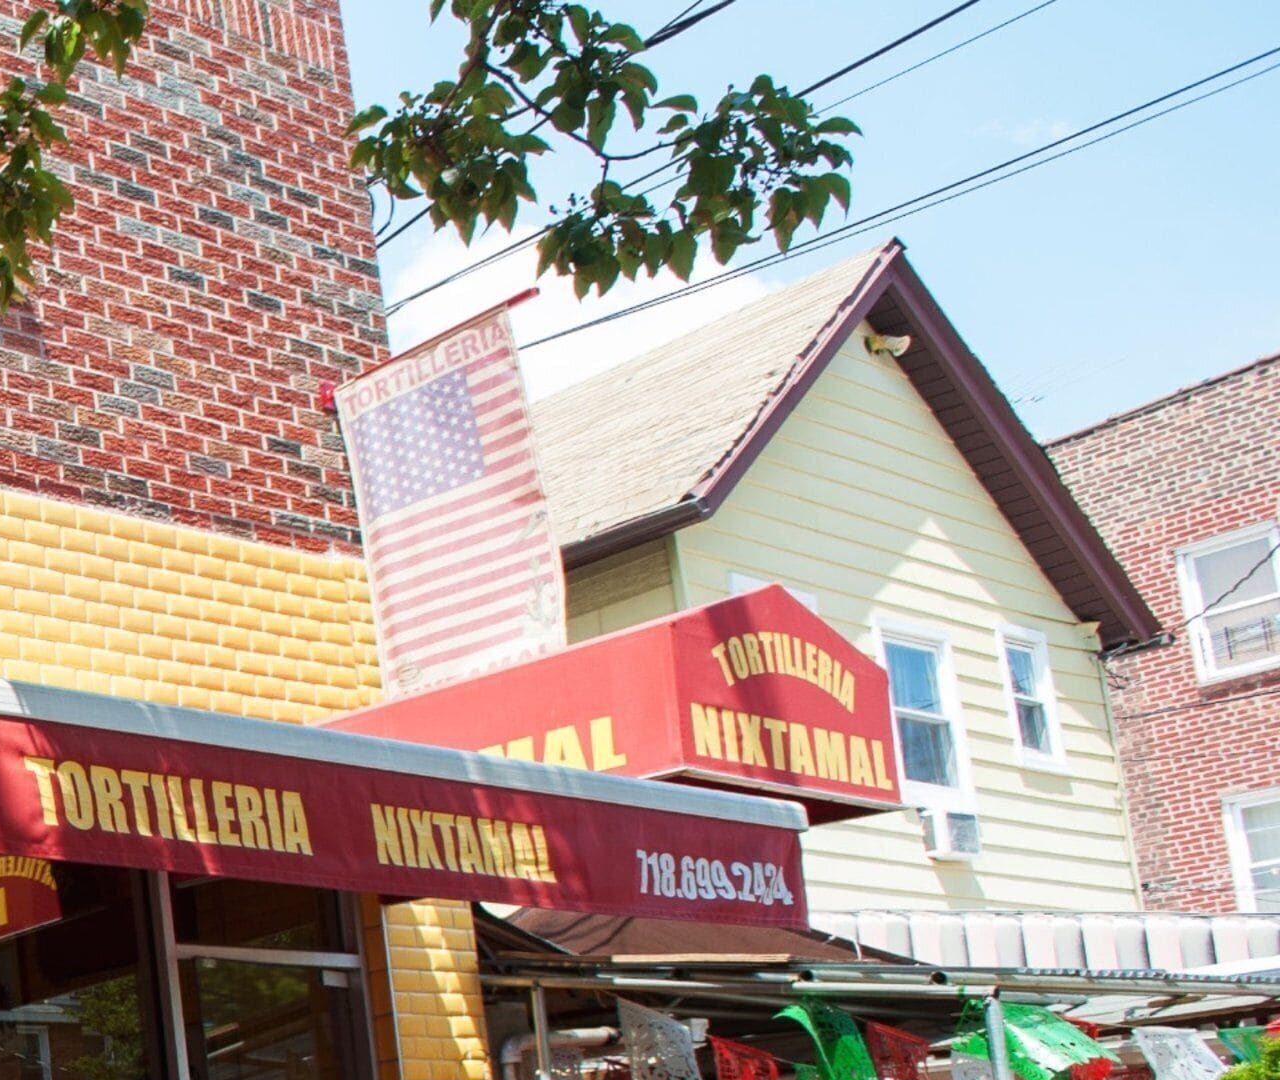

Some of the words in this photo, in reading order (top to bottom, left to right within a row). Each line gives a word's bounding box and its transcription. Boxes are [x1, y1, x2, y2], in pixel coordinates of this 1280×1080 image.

[344, 323, 508, 418] TORTILLERIA
[712, 632, 855, 714] TORTILLERIA
[690, 702, 894, 790] NIXTAMAL
[24, 756, 313, 856] TORTILLERIA
[370, 803, 555, 884] NIXTAMAL
